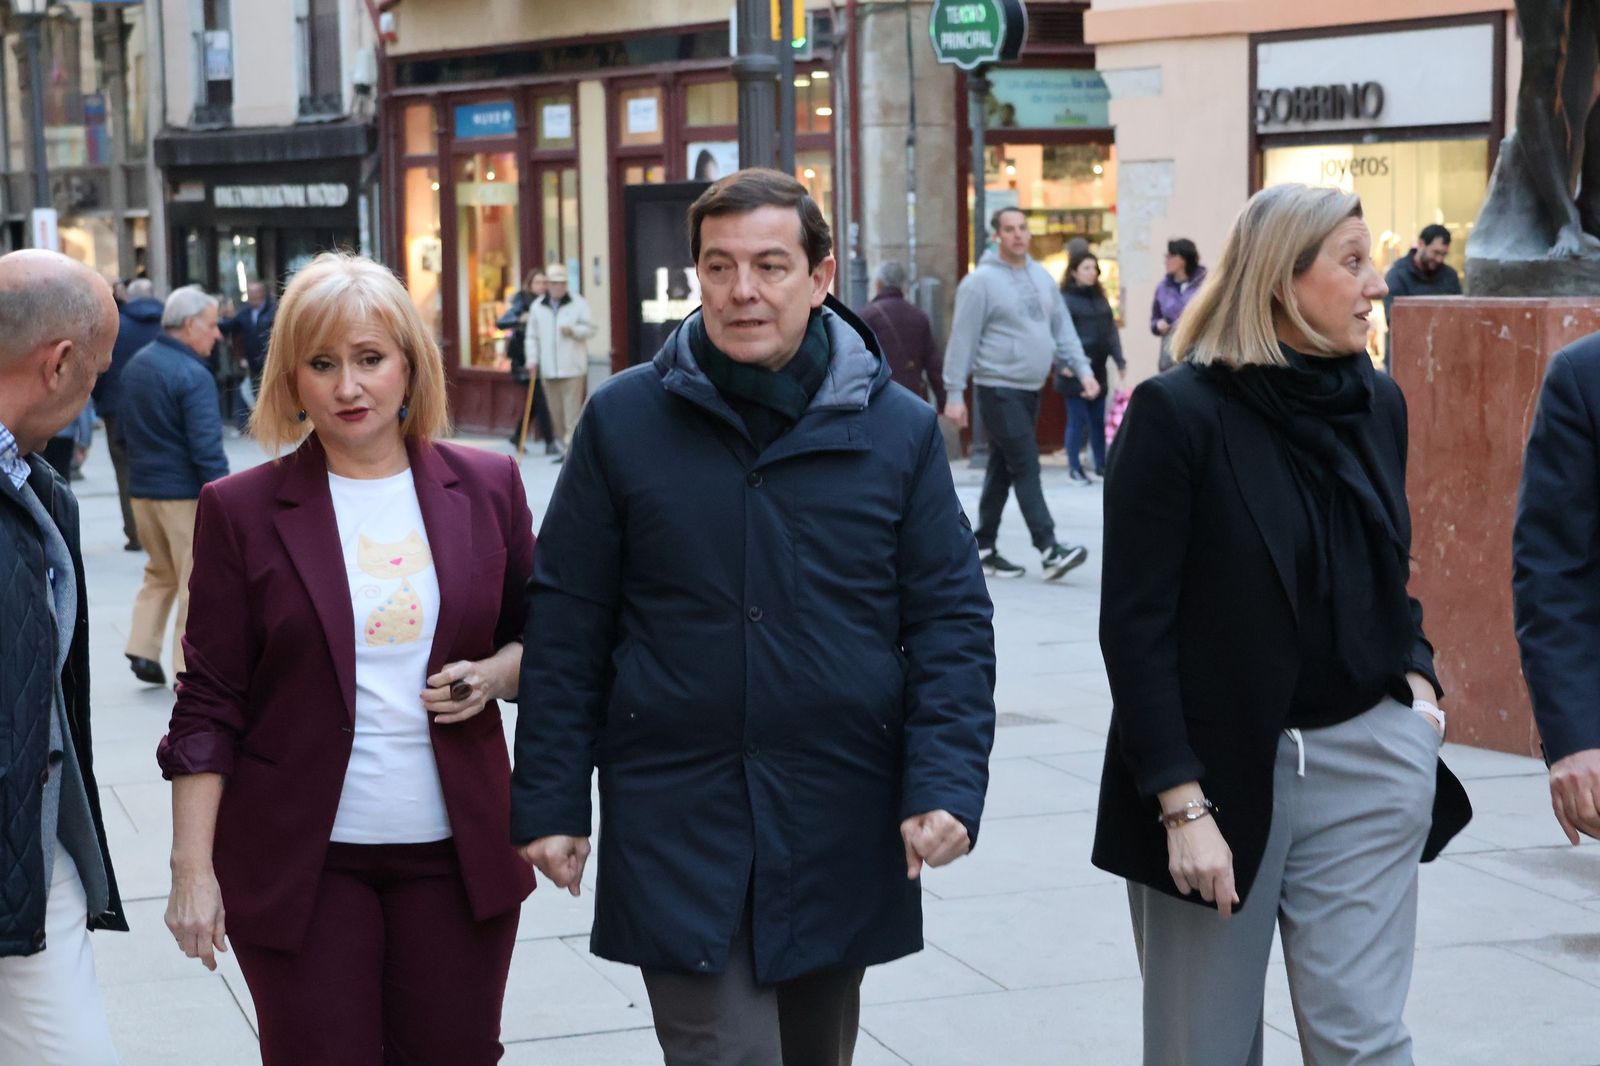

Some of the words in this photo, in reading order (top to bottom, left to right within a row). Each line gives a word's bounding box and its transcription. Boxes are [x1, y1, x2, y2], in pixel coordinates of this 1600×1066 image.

[945, 4, 987, 24] TEATRO
[940, 30, 993, 50] PRINCIPAL
[1256, 81, 1385, 126] SOBRINO
[1320, 156, 1389, 183] joyeros
